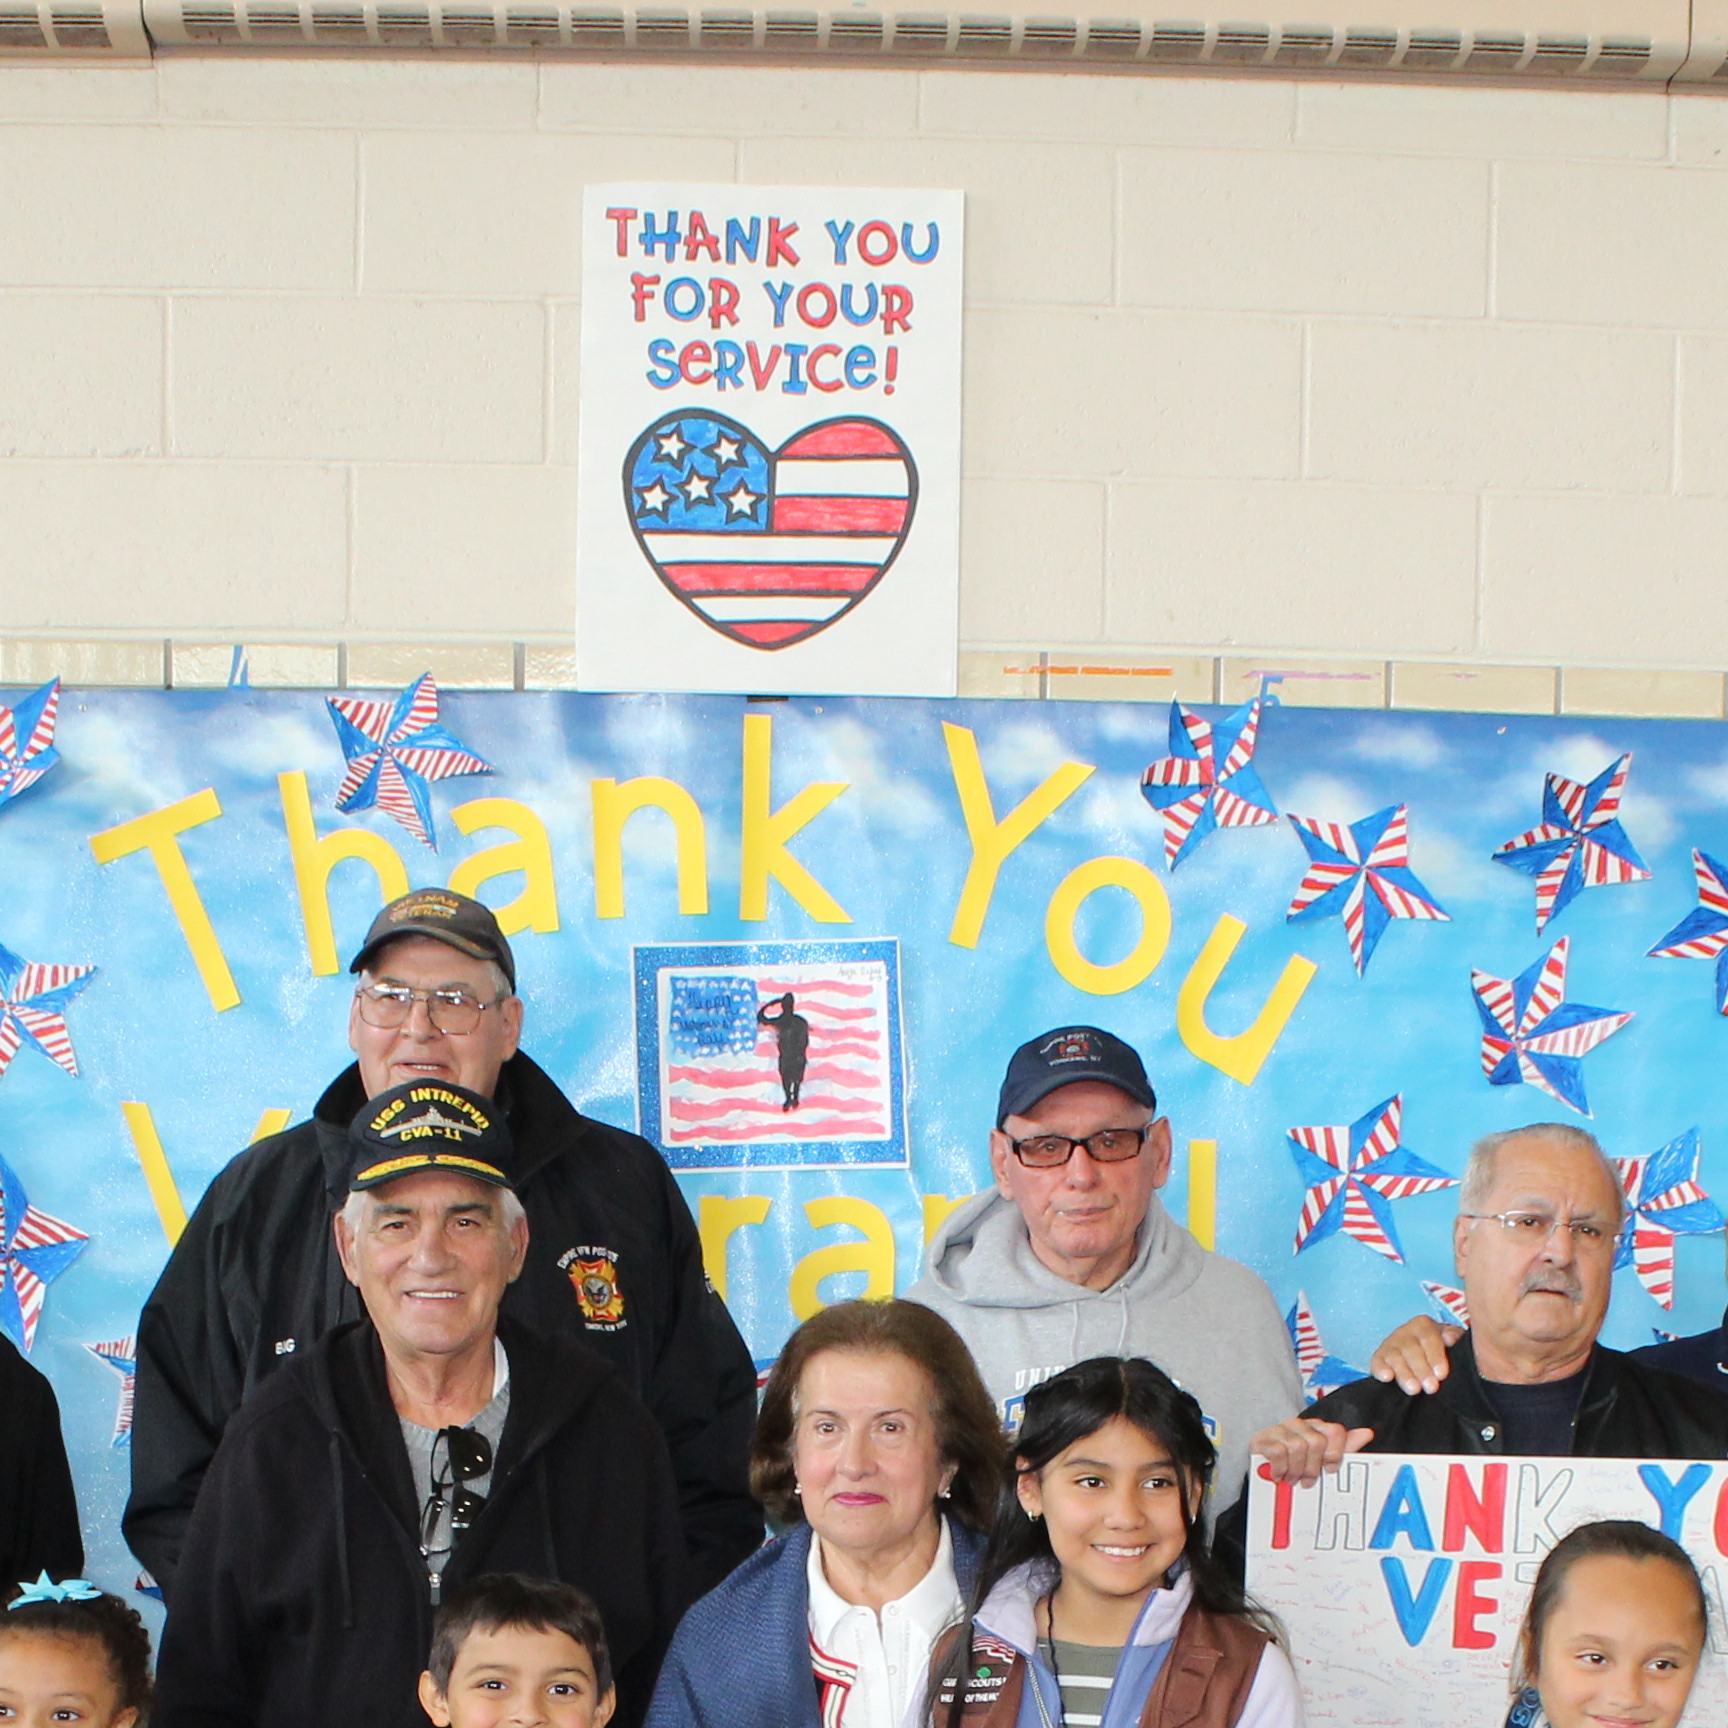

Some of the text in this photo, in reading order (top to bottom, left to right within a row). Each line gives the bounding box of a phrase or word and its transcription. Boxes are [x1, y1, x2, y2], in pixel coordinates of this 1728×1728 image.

[606, 207, 940, 267] THANK YOU
[630, 272, 914, 335] FOR YOUR
[89, 713, 1317, 1086] Thank You
[369, 1088, 490, 1131] USS INTREPID
[400, 1125, 462, 1141] CVA-11
[1257, 1462, 1574, 1554] THANK
